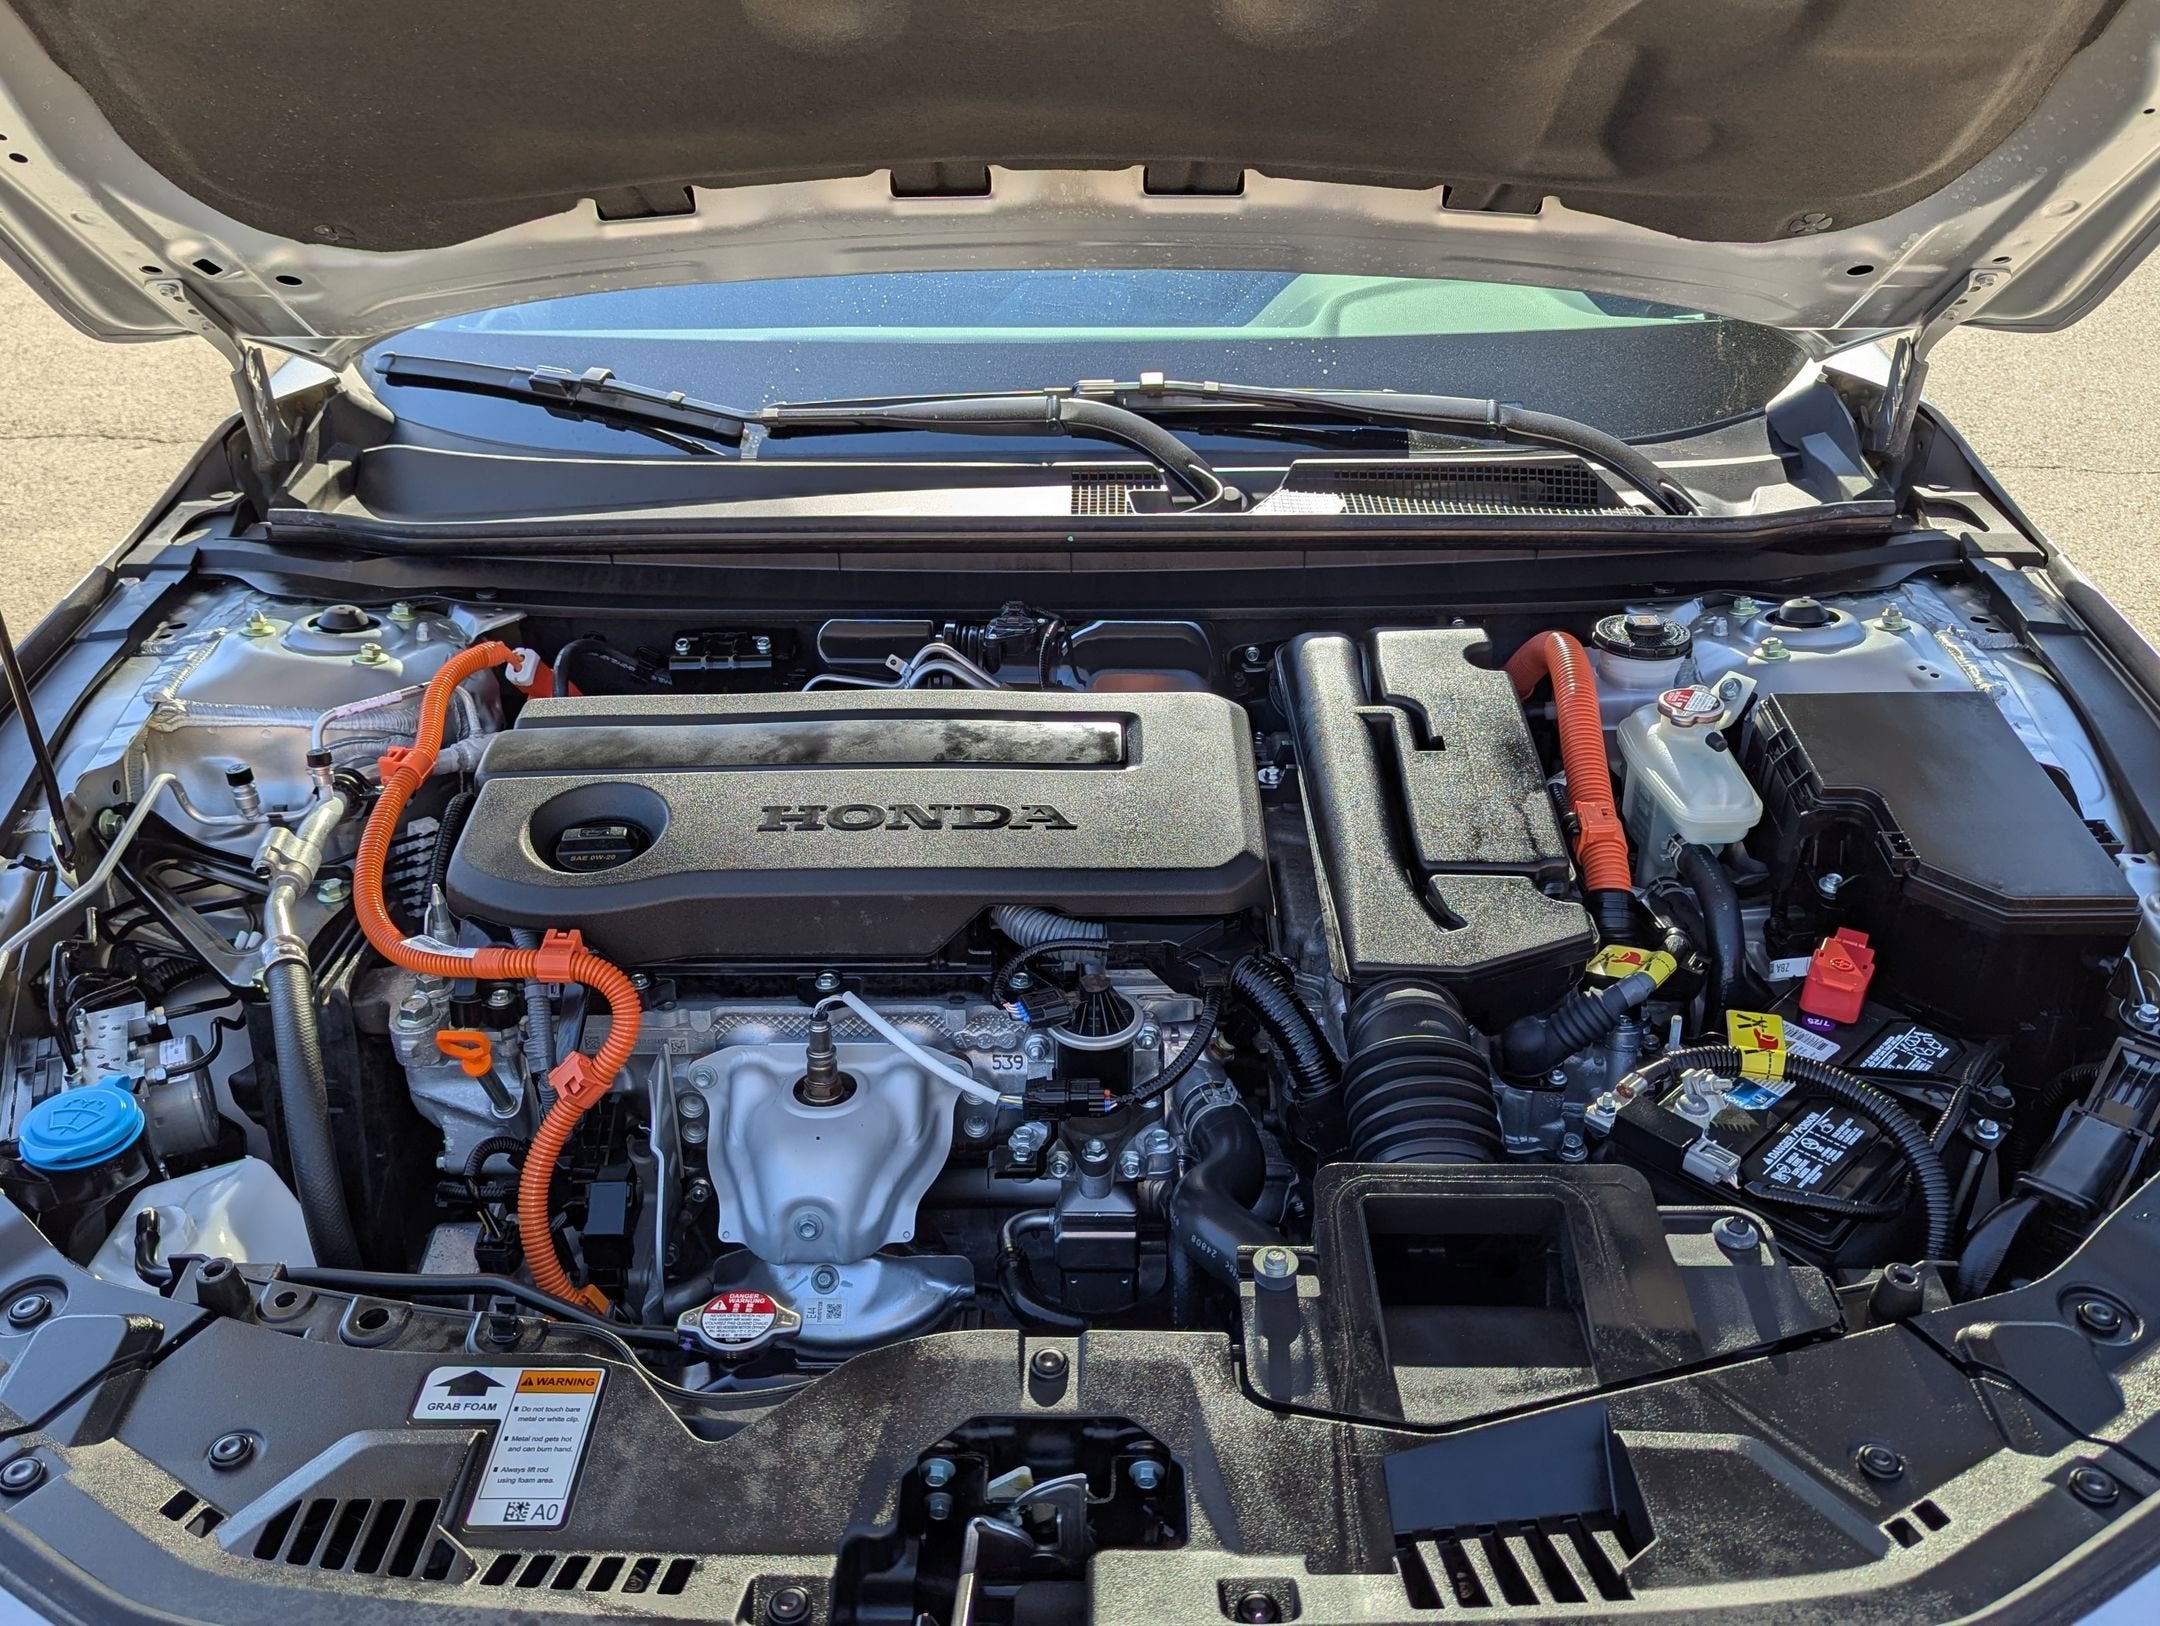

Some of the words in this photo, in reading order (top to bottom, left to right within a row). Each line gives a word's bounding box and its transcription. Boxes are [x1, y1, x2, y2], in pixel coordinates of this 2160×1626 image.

[757, 803, 1077, 831] HONDA
[992, 1054, 1024, 1070] 539
[1767, 1135, 1797, 1160] DANGER
[1793, 1111, 1820, 1134] POISON
[536, 1377, 595, 1387] WARNING
[427, 1402, 461, 1411] GRAB
[463, 1402, 498, 1411] FOAM
[530, 1503, 559, 1521] A0
